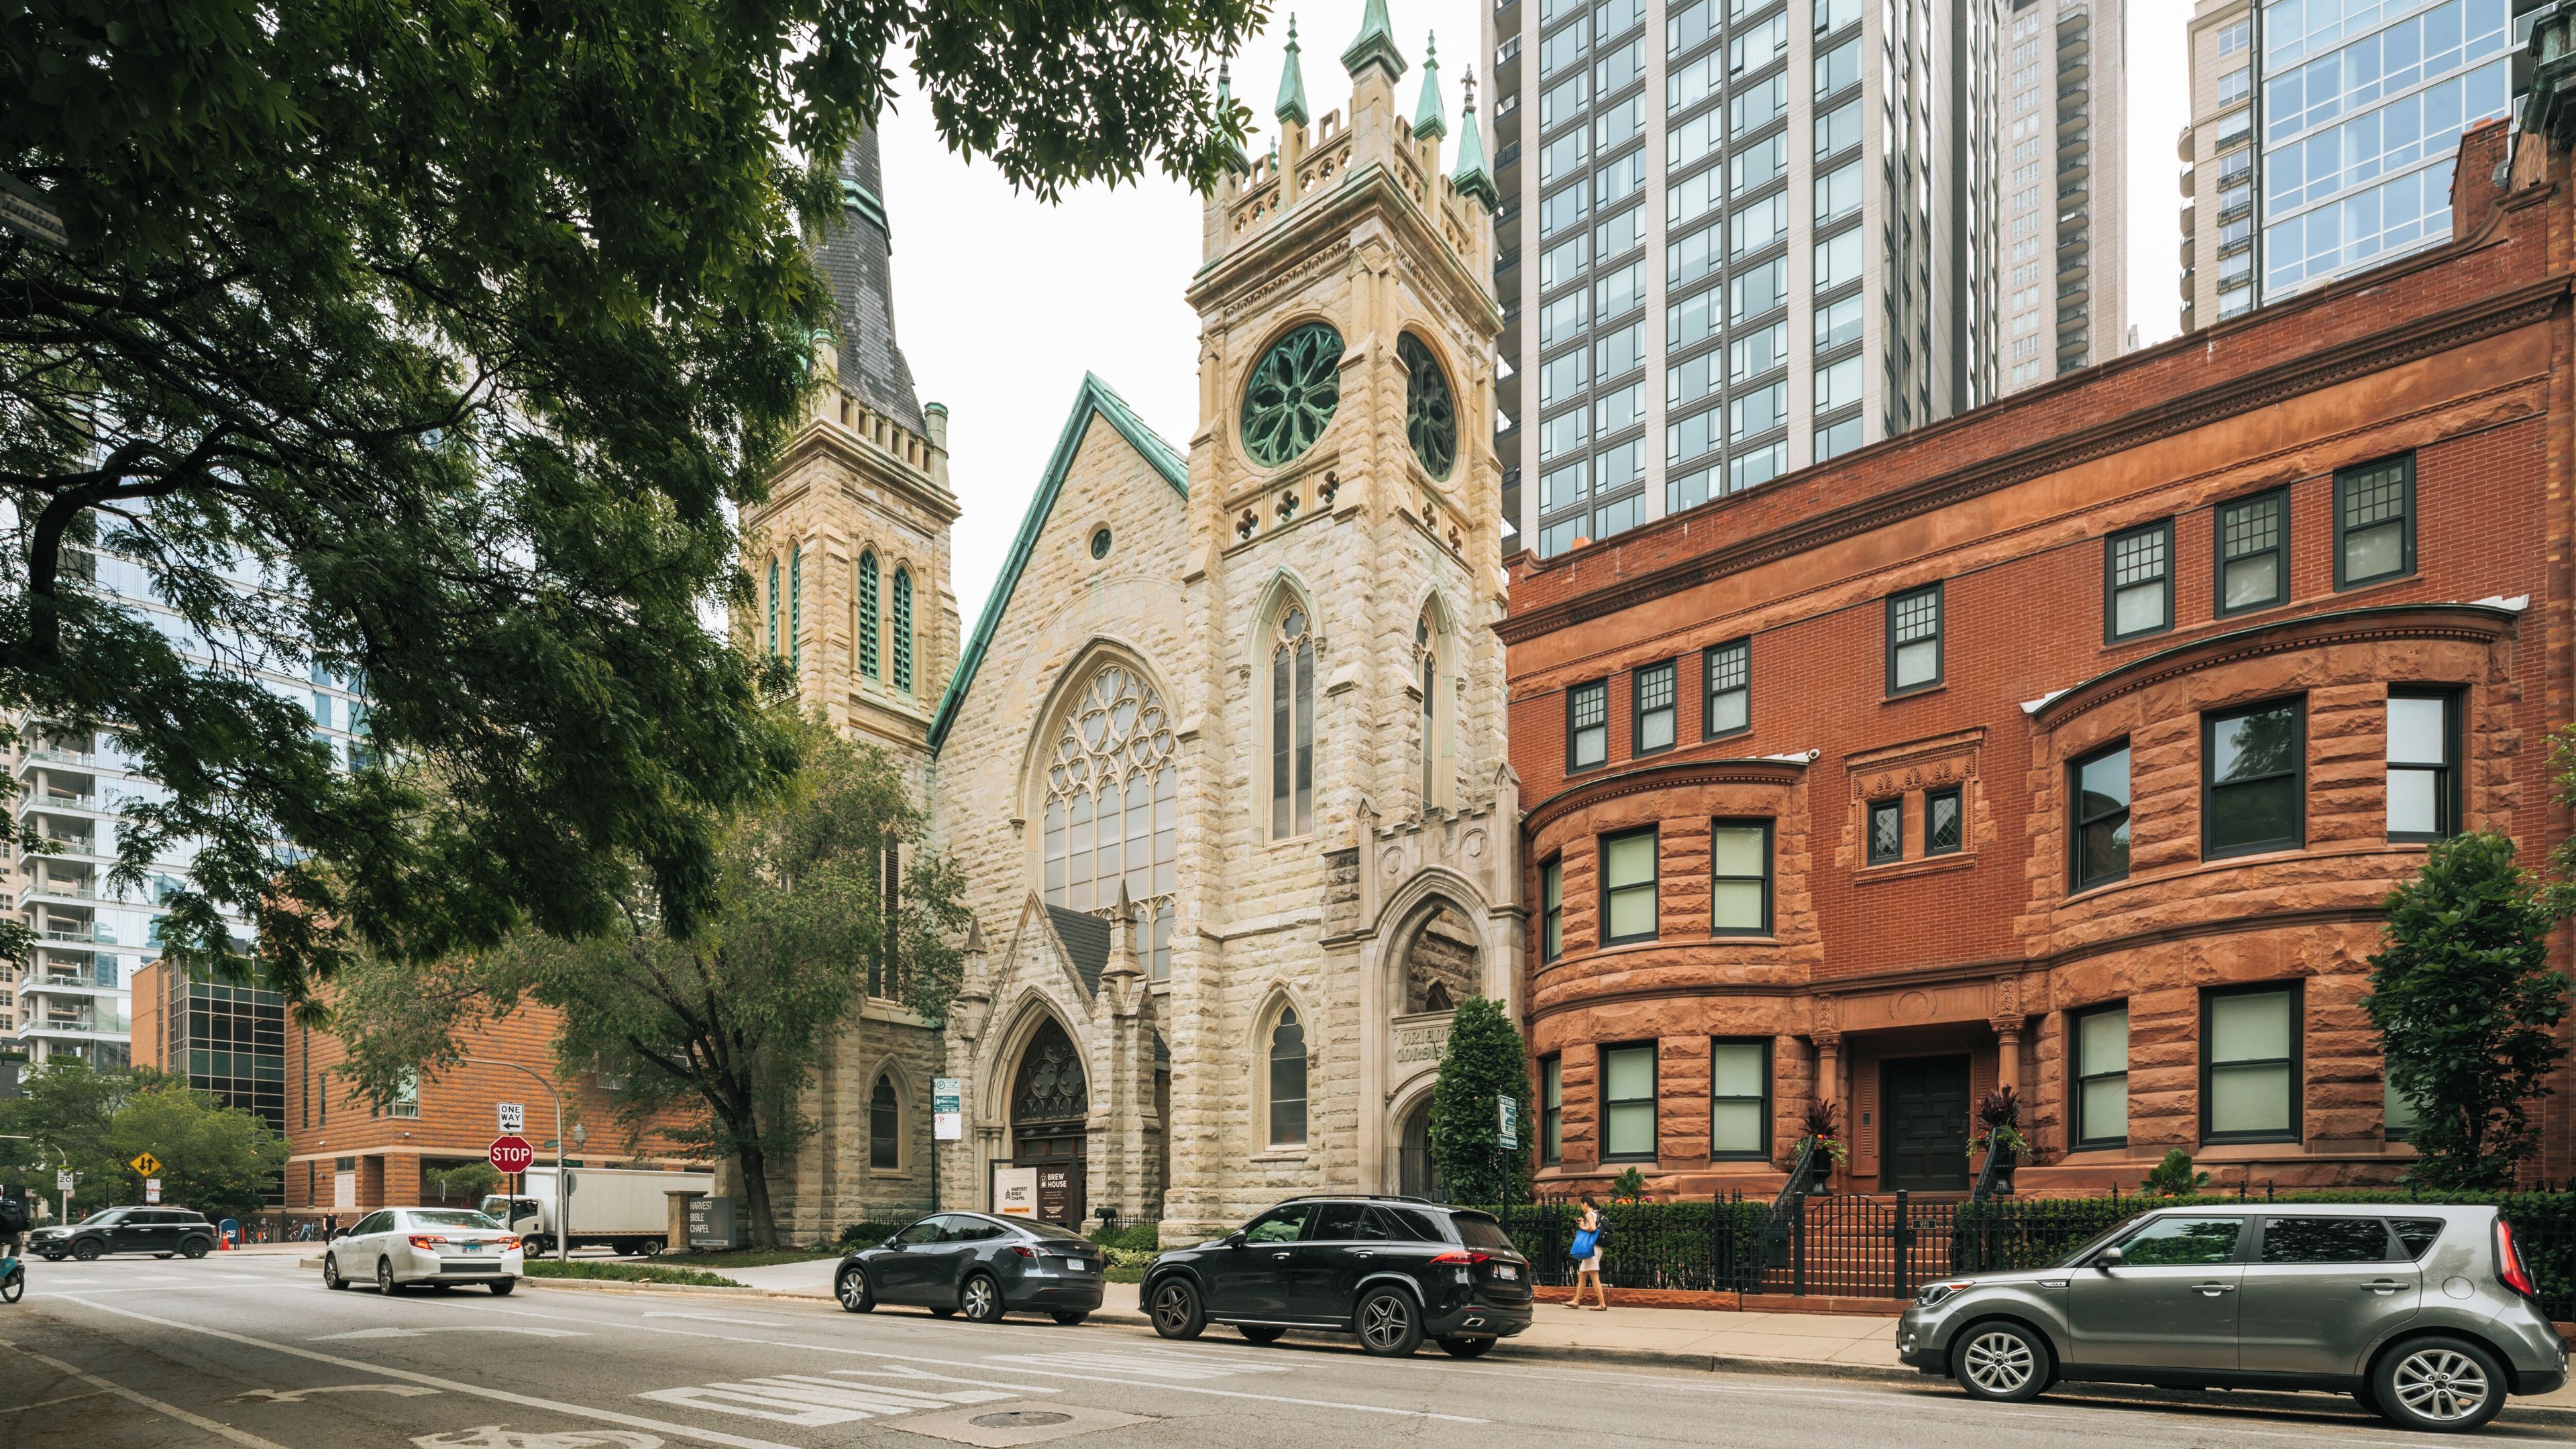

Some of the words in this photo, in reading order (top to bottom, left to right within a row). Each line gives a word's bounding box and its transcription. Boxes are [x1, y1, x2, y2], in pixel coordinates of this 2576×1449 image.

[501, 1106, 520, 1114] ONE
[492, 1147, 530, 1162] STOP
[1047, 1173, 1065, 1181] BREW
[1047, 1180, 1067, 1188] HOUSE
[690, 1201, 712, 1210] HARVEST
[690, 1212, 704, 1222] BIBLE
[690, 1224, 710, 1233] CHAPEL
[628, 1365, 1065, 1427] ONLY
